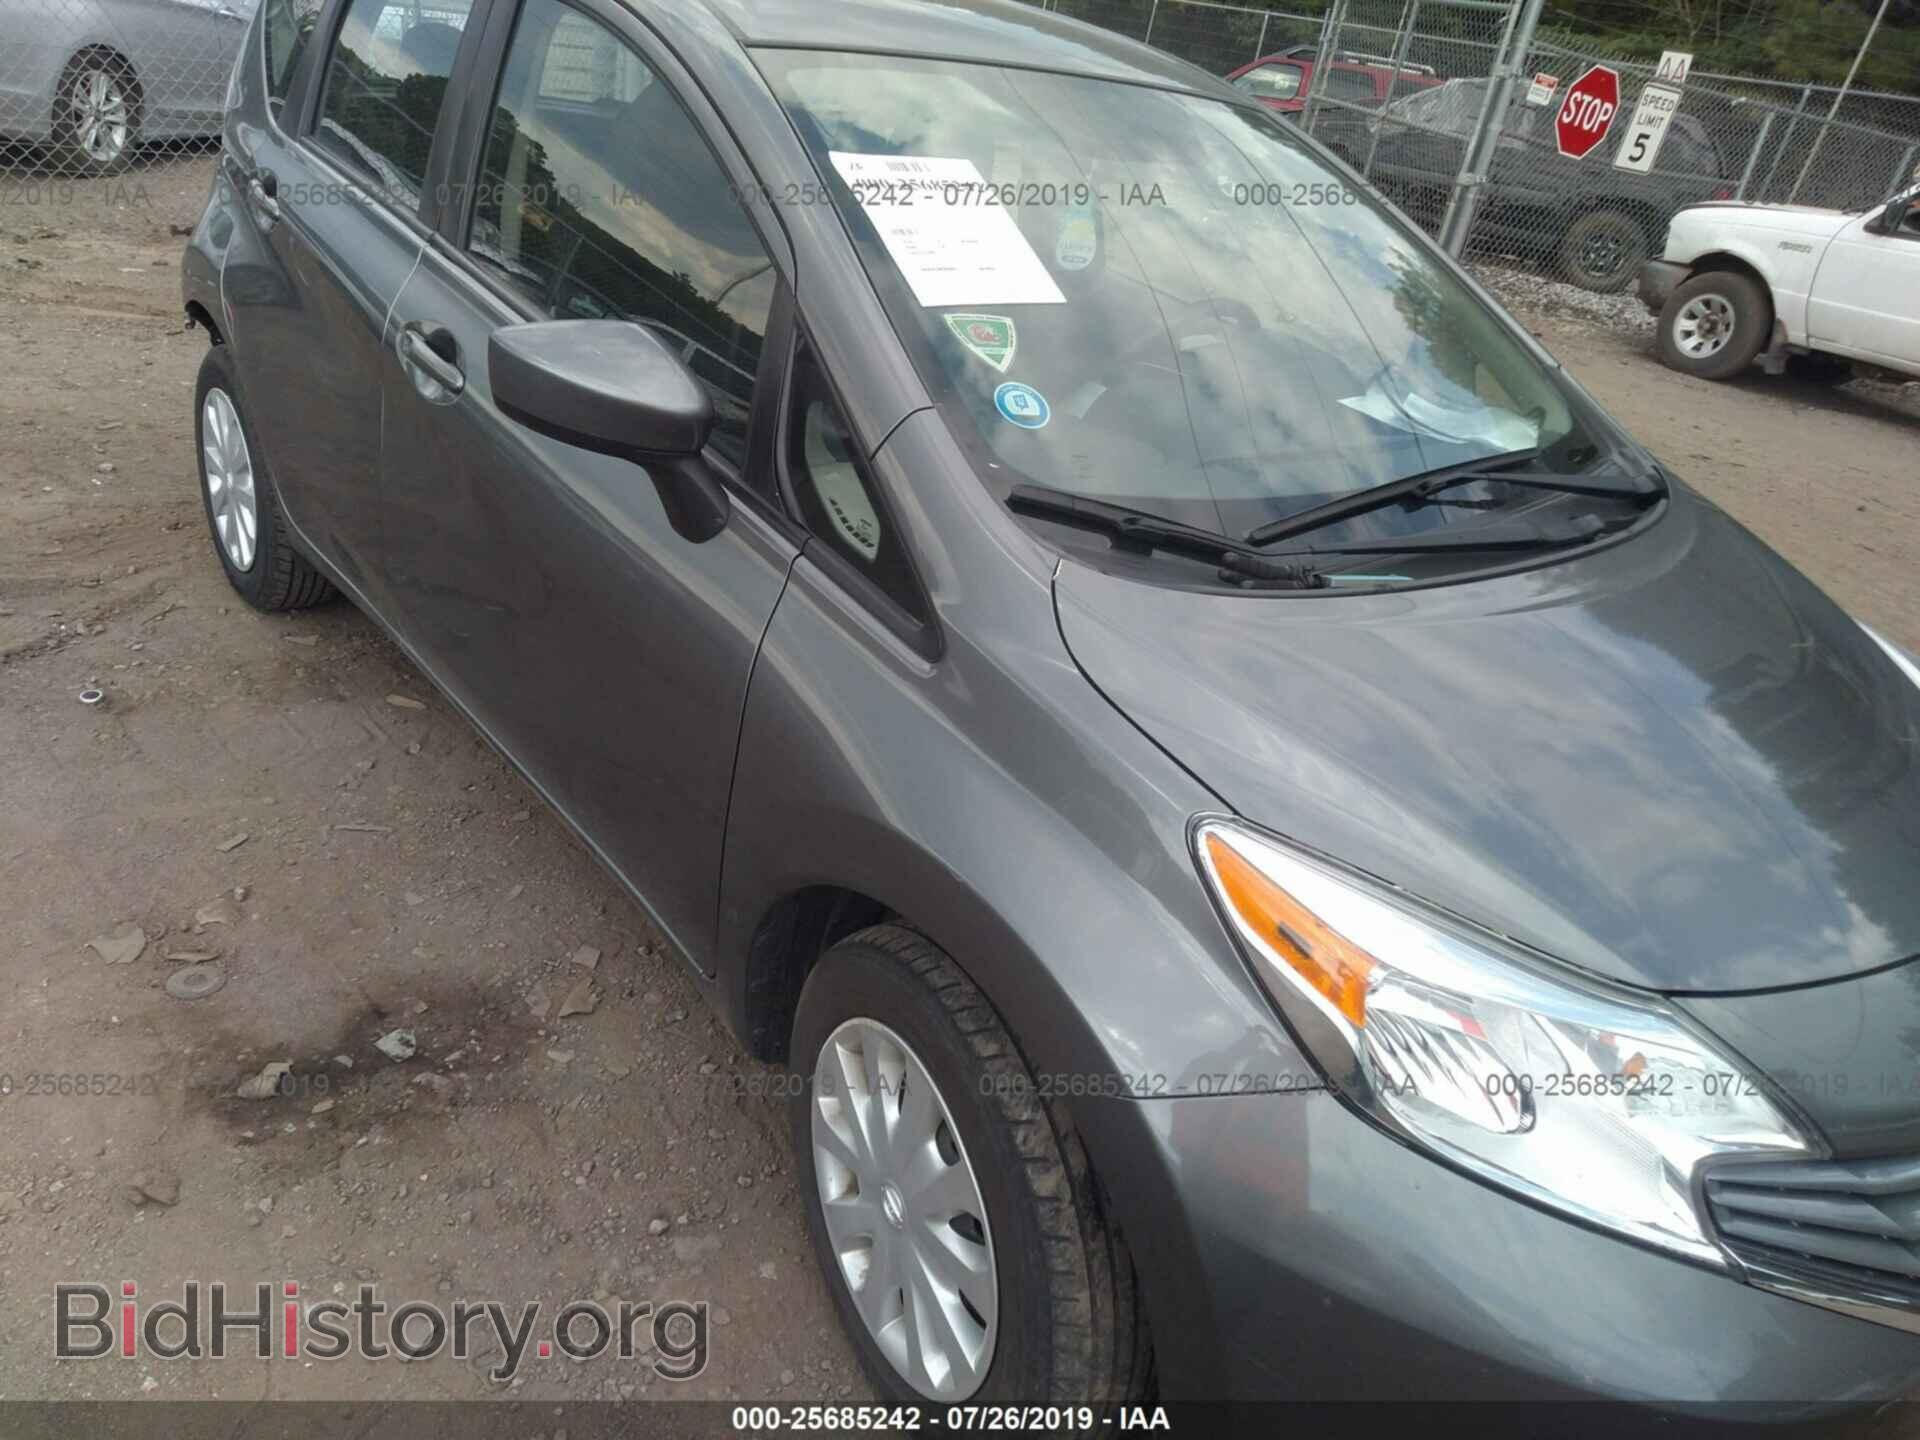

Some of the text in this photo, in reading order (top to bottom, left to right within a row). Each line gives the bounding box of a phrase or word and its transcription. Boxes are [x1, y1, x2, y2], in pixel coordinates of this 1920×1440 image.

[1562, 91, 1614, 133] STOP
[1642, 93, 1675, 112] SPEED
[1636, 114, 1665, 129] LIMIT
[1628, 132, 1651, 162] 5
